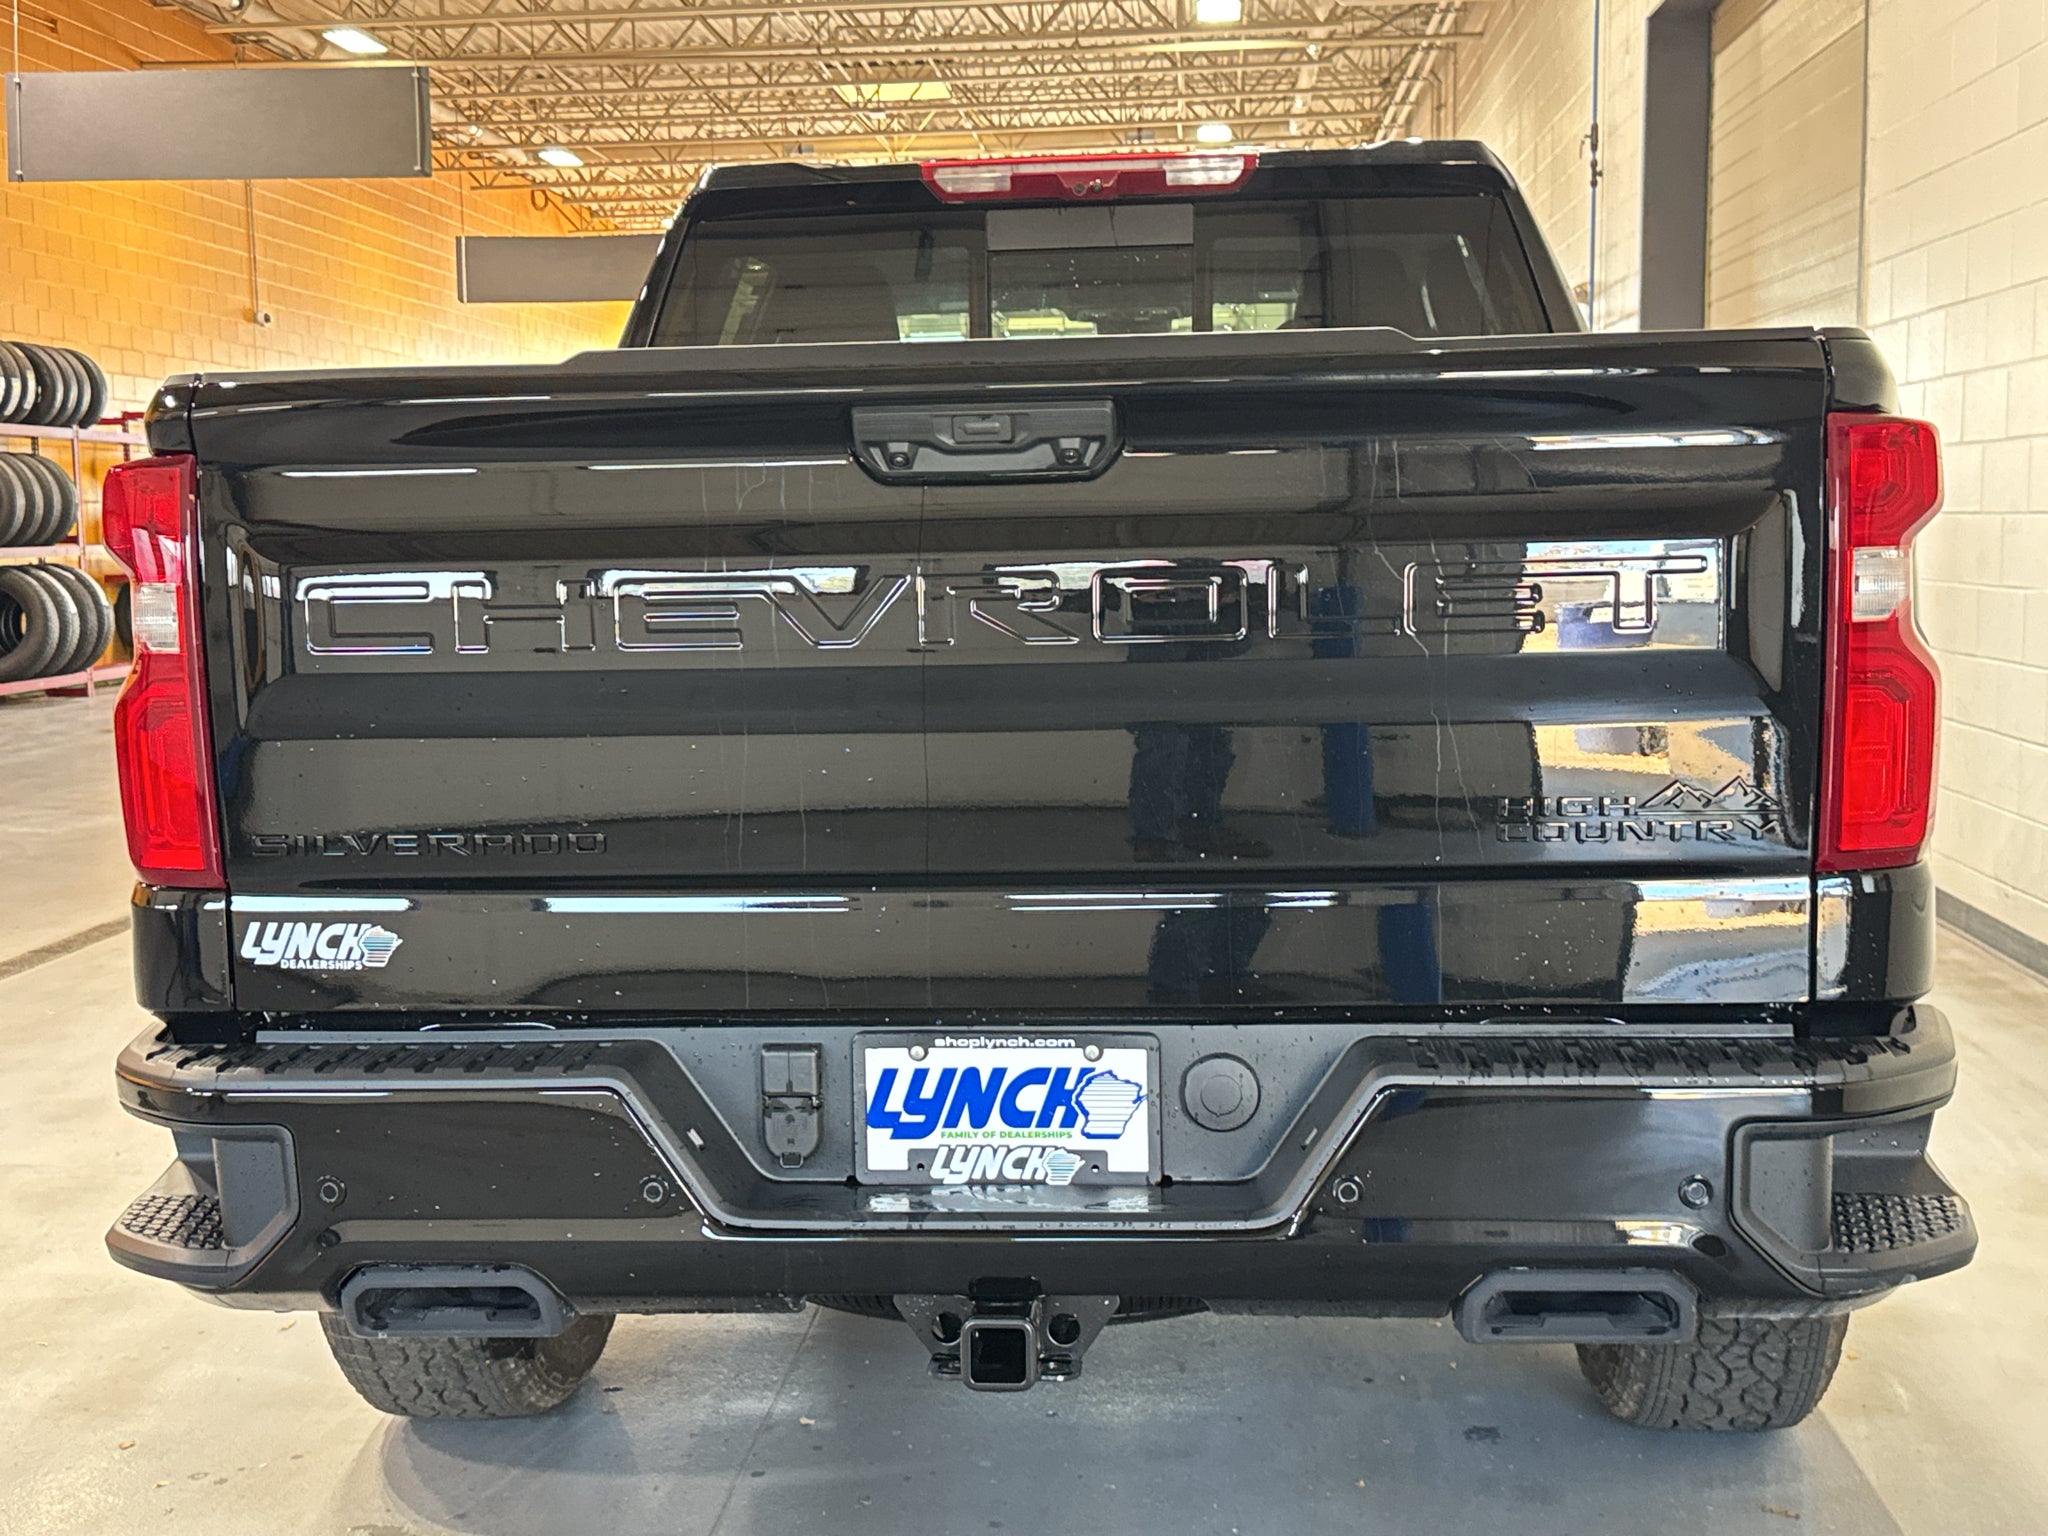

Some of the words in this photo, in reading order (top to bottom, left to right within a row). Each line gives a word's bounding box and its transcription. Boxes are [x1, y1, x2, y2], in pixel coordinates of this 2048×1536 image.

[303, 553, 1710, 656] CHEVROLET
[1497, 795, 1638, 817] HIGH
[1497, 819, 1779, 843] COUNTRY
[251, 832, 608, 858] SILVERADO
[240, 921, 373, 965] LYNCH
[280, 958, 364, 971] DEALERSHIPS
[934, 1036, 1076, 1049] shoplynch.com
[866, 1066, 1096, 1140] LYNCH
[940, 1130, 979, 1139] FAMILY
[981, 1130, 997, 1139] OF
[999, 1130, 1073, 1139] DEALERSHIPS
[929, 1144, 1056, 1185] LYNCH
